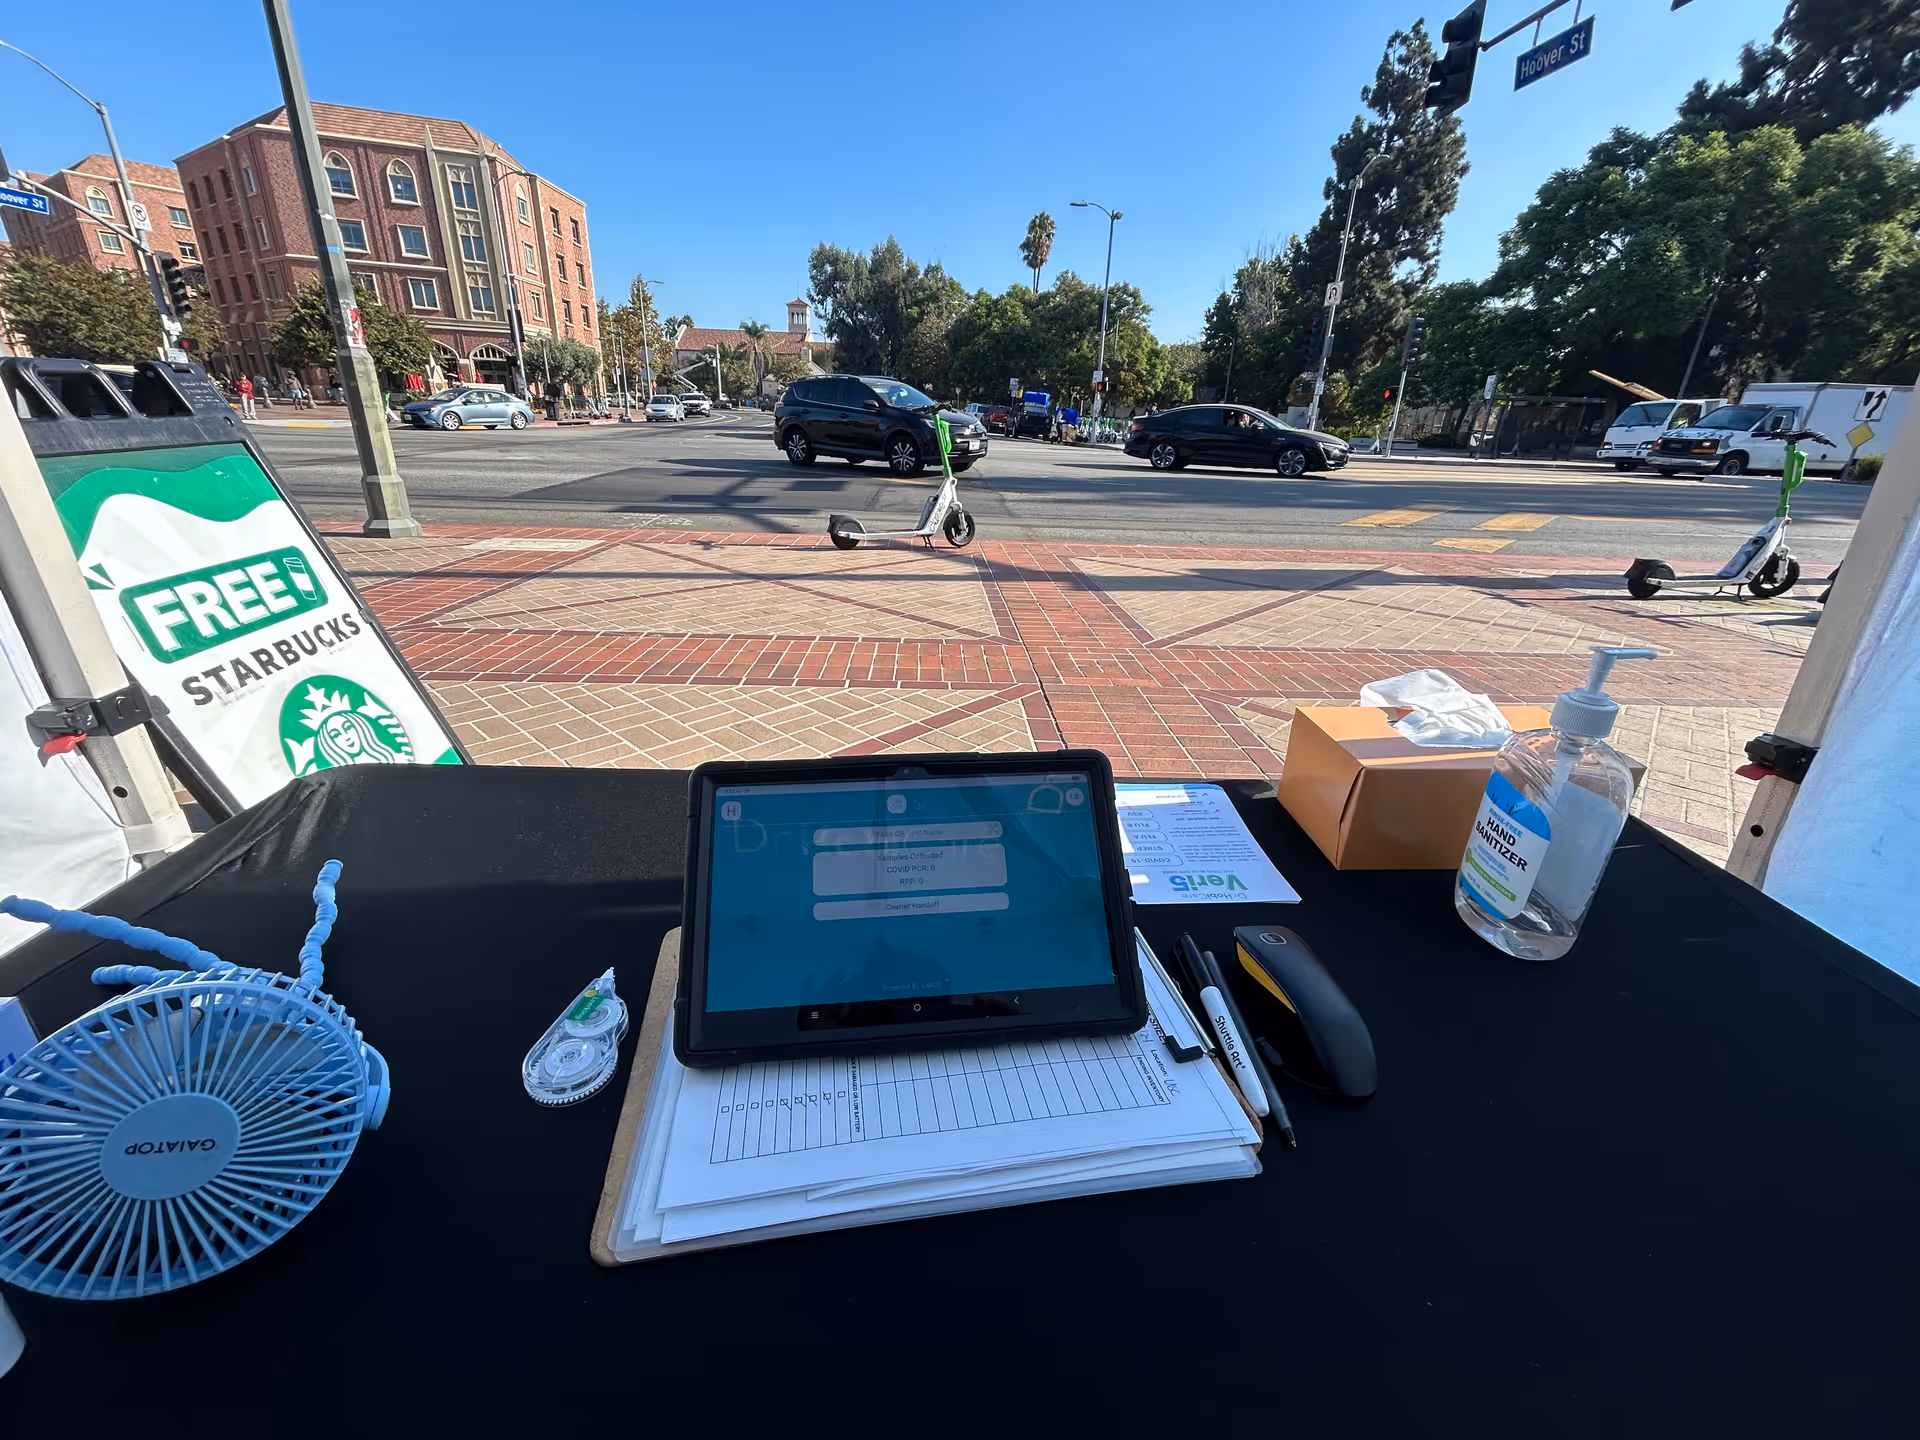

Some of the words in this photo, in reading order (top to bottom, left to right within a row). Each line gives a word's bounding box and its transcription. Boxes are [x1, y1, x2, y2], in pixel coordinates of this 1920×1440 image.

[1521, 45, 1565, 79] Hoover
[1570, 30, 1585, 54] St
[0, 192, 28, 205] oover
[32, 198, 44, 209] St
[133, 560, 298, 652] FREE
[181, 613, 361, 706] STARBUCKS
[1487, 816, 1516, 847] HAND
[878, 852, 909, 861] Samples
[910, 852, 944, 860] Collected
[1476, 821, 1528, 872] SANITIZER
[1169, 874, 1248, 891] Veri5
[912, 901, 940, 909] Handoff
[1150, 1018, 1166, 1045] SHEE
[1215, 1015, 1235, 1051] Shuttle
[1151, 1049, 1169, 1077] Location:
[1137, 1057, 1150, 1075] ENDING
[1146, 1075, 1166, 1103] INVENTORY
[853, 1092, 859, 1100] OR
[124, 1138, 216, 1155] GAIATOP
